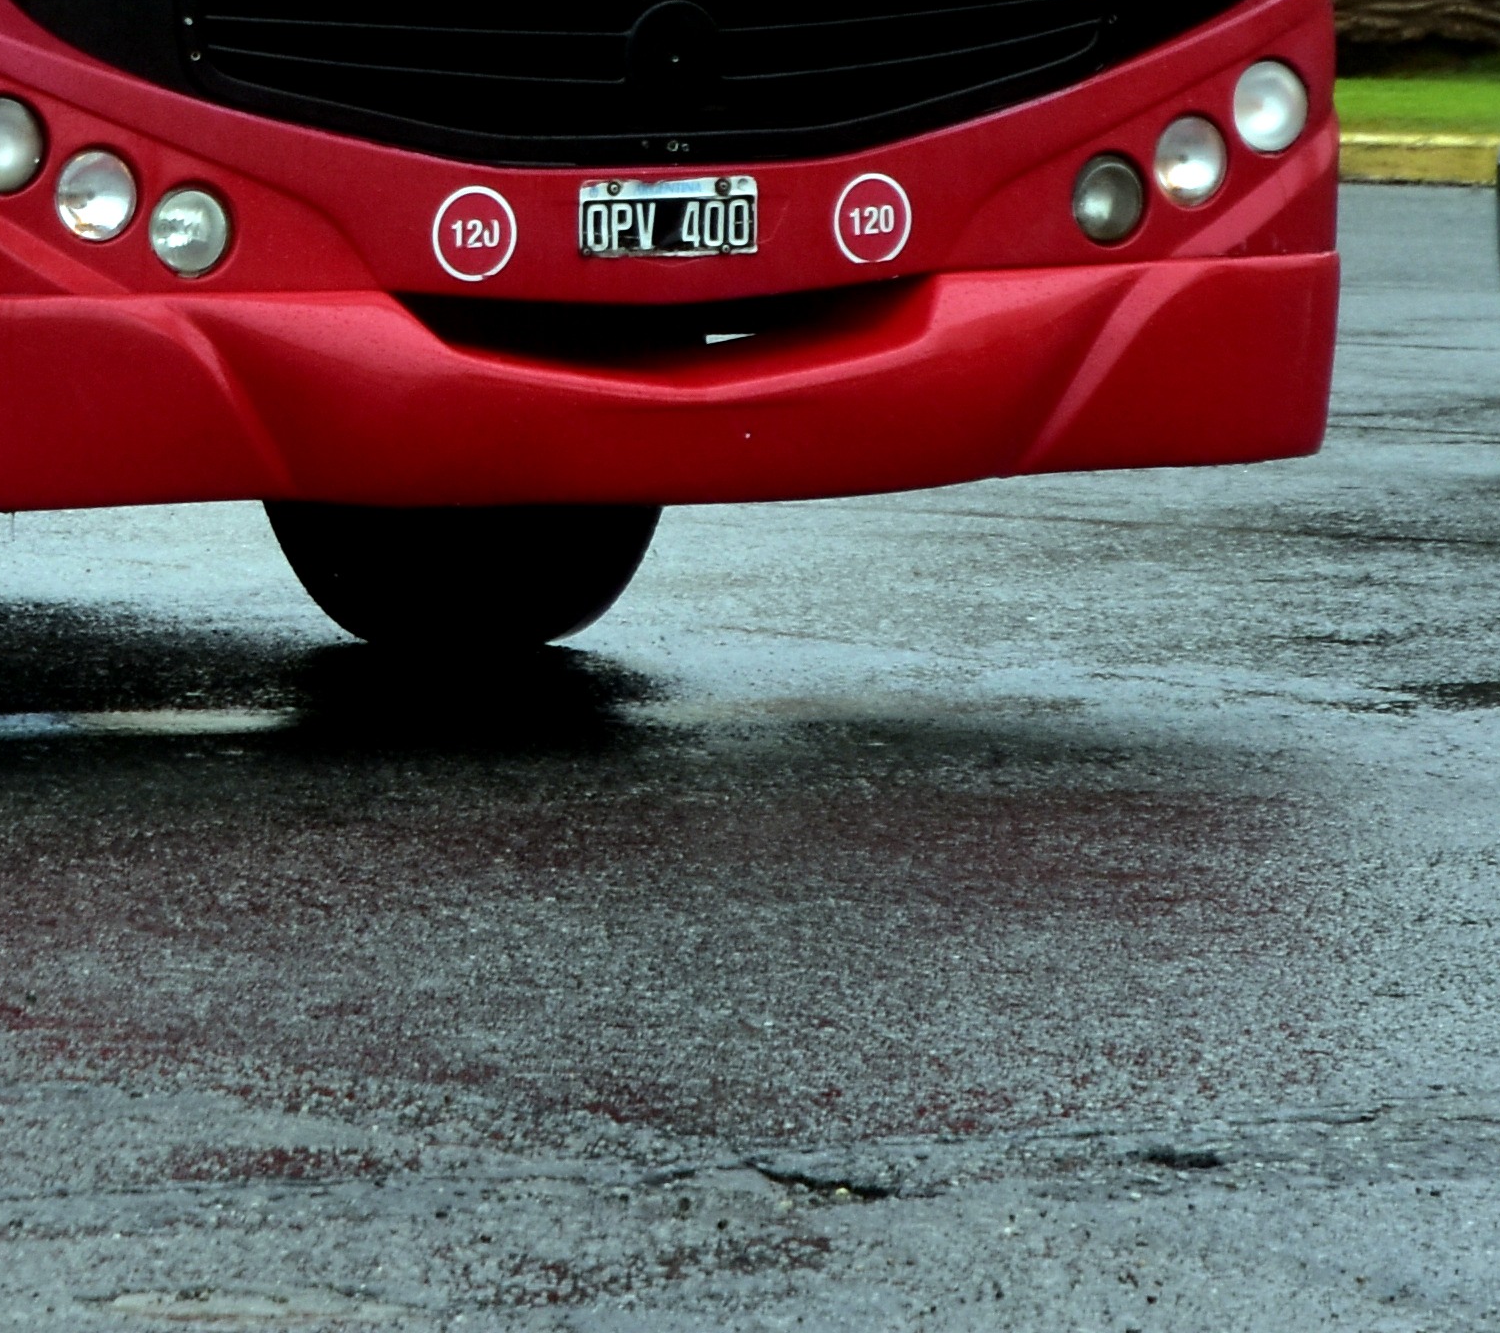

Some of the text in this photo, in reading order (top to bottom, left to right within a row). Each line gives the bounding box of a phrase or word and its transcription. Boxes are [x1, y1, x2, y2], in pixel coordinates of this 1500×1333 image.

[586, 198, 750, 252] OPV 400
[850, 204, 896, 237] 120
